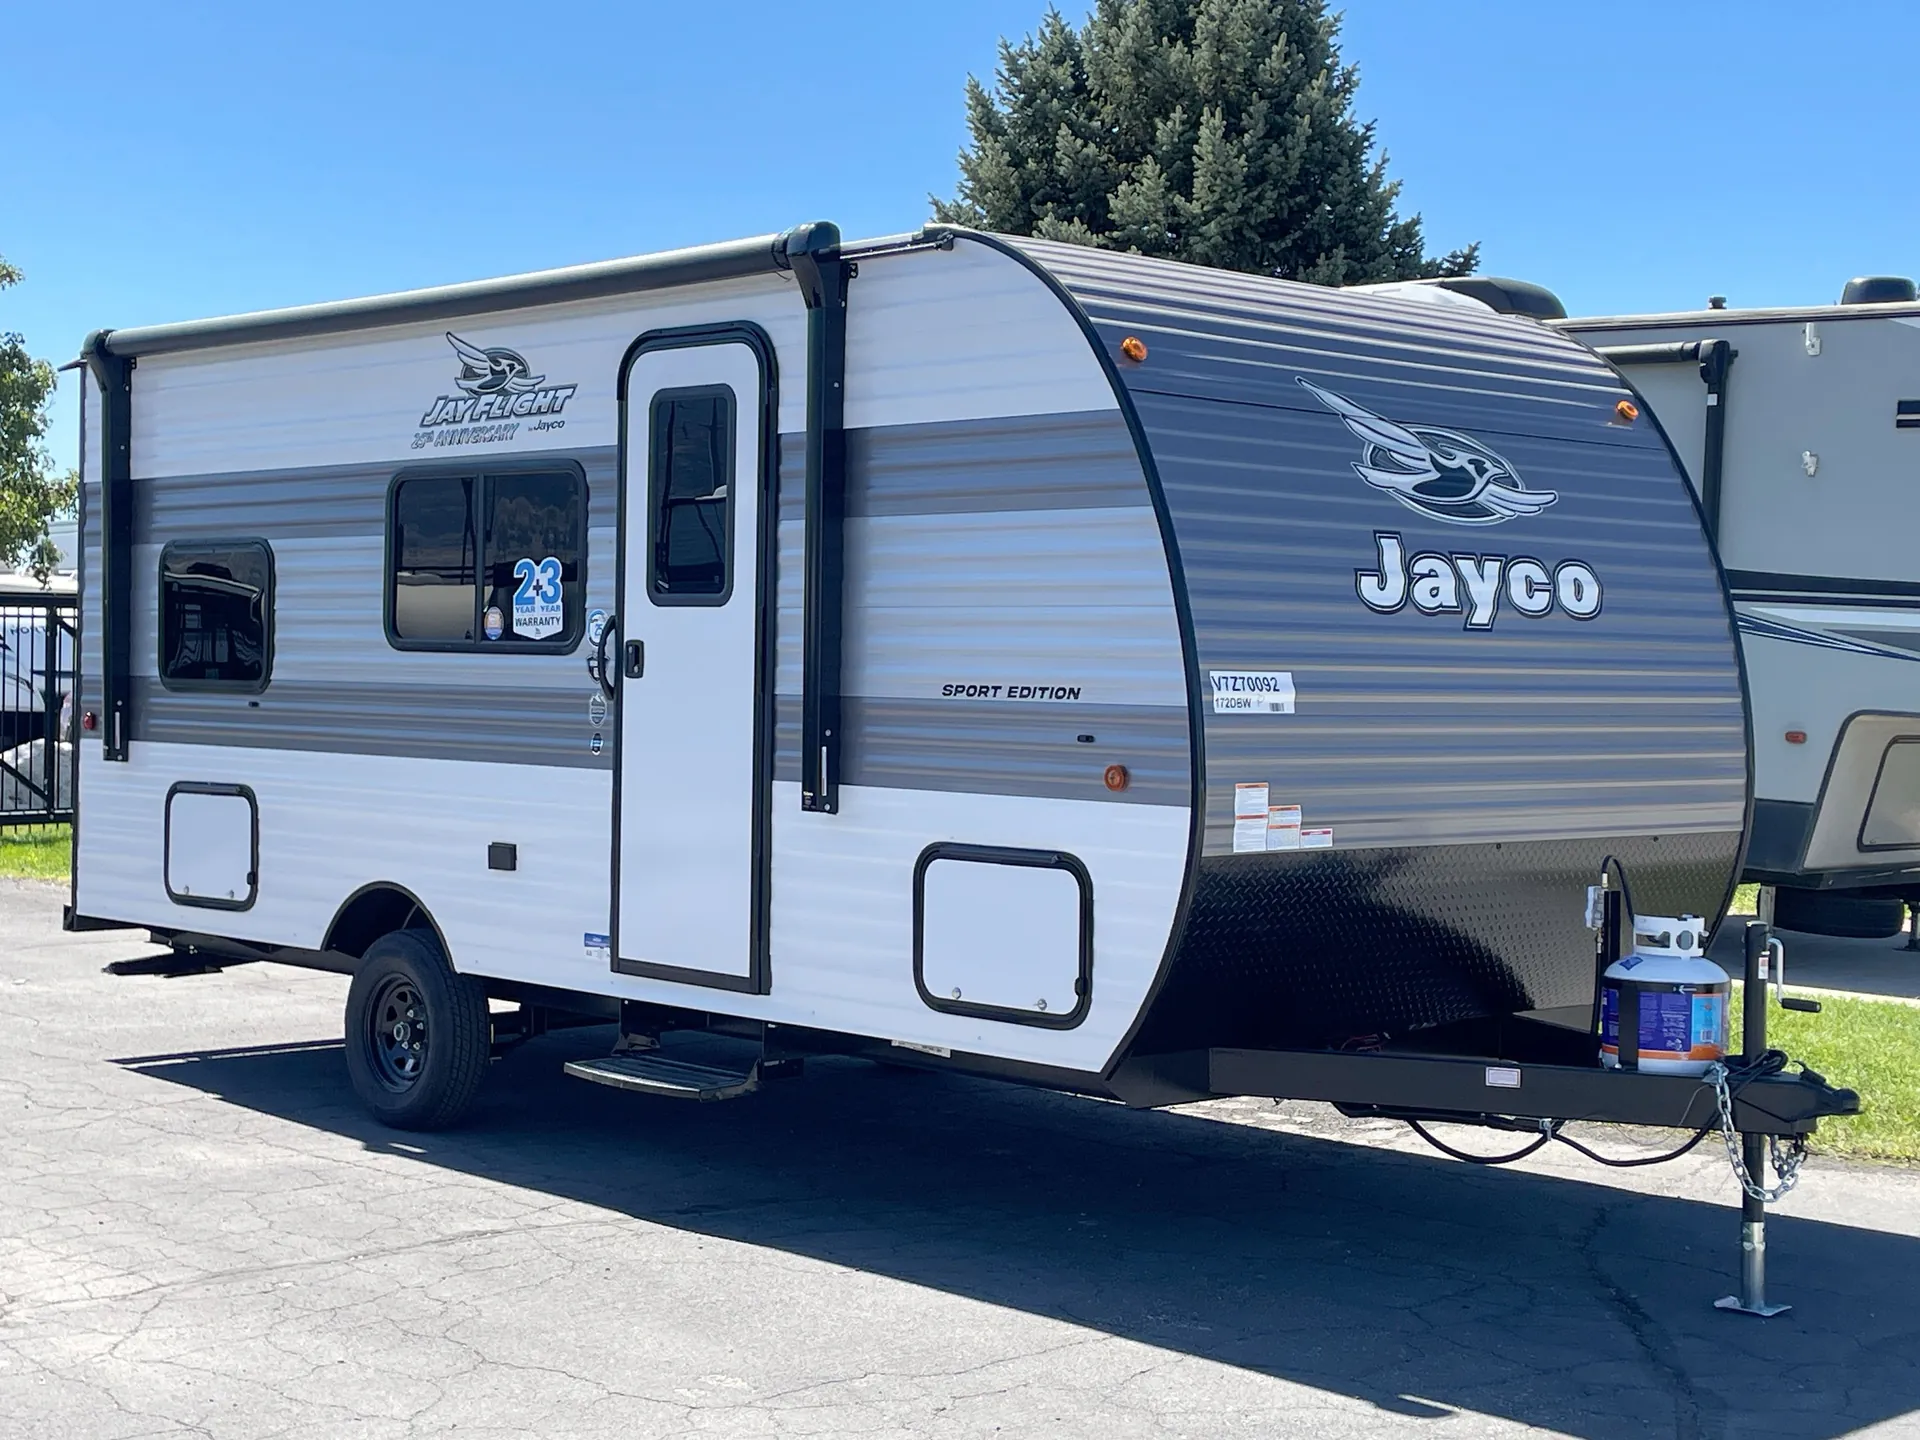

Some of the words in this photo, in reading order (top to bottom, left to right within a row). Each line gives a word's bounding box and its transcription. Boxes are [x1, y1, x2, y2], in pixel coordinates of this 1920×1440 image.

[419, 395, 476, 427] JAY
[468, 383, 578, 422] FLIGHT
[534, 419, 566, 433] Jayco
[433, 422, 520, 447] ANNIVERSARY
[1354, 530, 1604, 632] Jayco
[515, 605, 536, 613] YEAR
[540, 604, 561, 612] YEAR
[515, 616, 561, 627] WARRANTY
[942, 684, 1002, 697] SPORT
[1007, 685, 1082, 700] EDITION
[1211, 676, 1280, 692] V7Z70092
